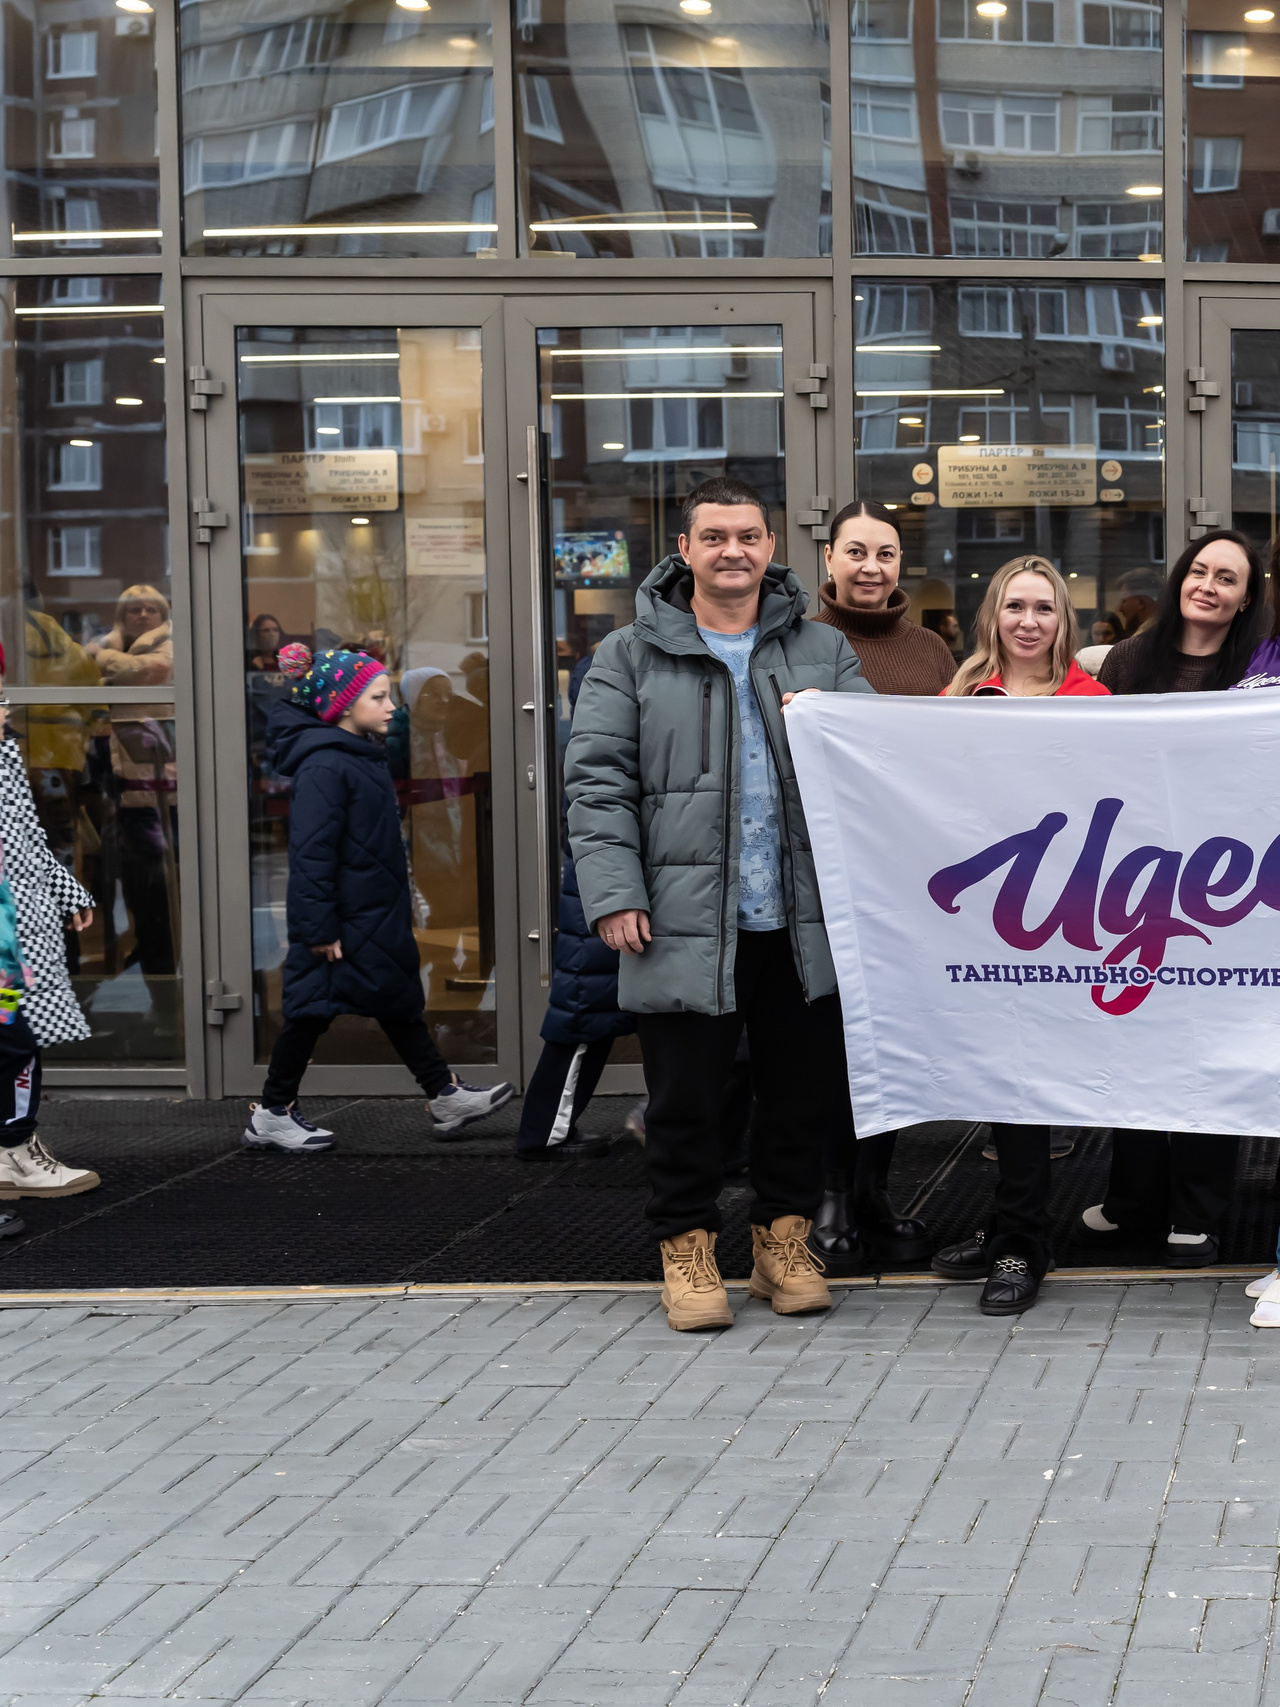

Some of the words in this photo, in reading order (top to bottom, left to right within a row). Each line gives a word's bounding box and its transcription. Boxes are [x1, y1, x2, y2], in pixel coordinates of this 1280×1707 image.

[979, 447, 1024, 458] ПАРТЕР
[282, 455, 326, 464] ПАРТЕР
[948, 465, 990, 473] ТРИБУНЫ
[1027, 463, 1069, 472] ТРИБУНЫ
[952, 491, 981, 499] ЛОЖИ
[1028, 490, 1058, 498] ЛОЖИ
